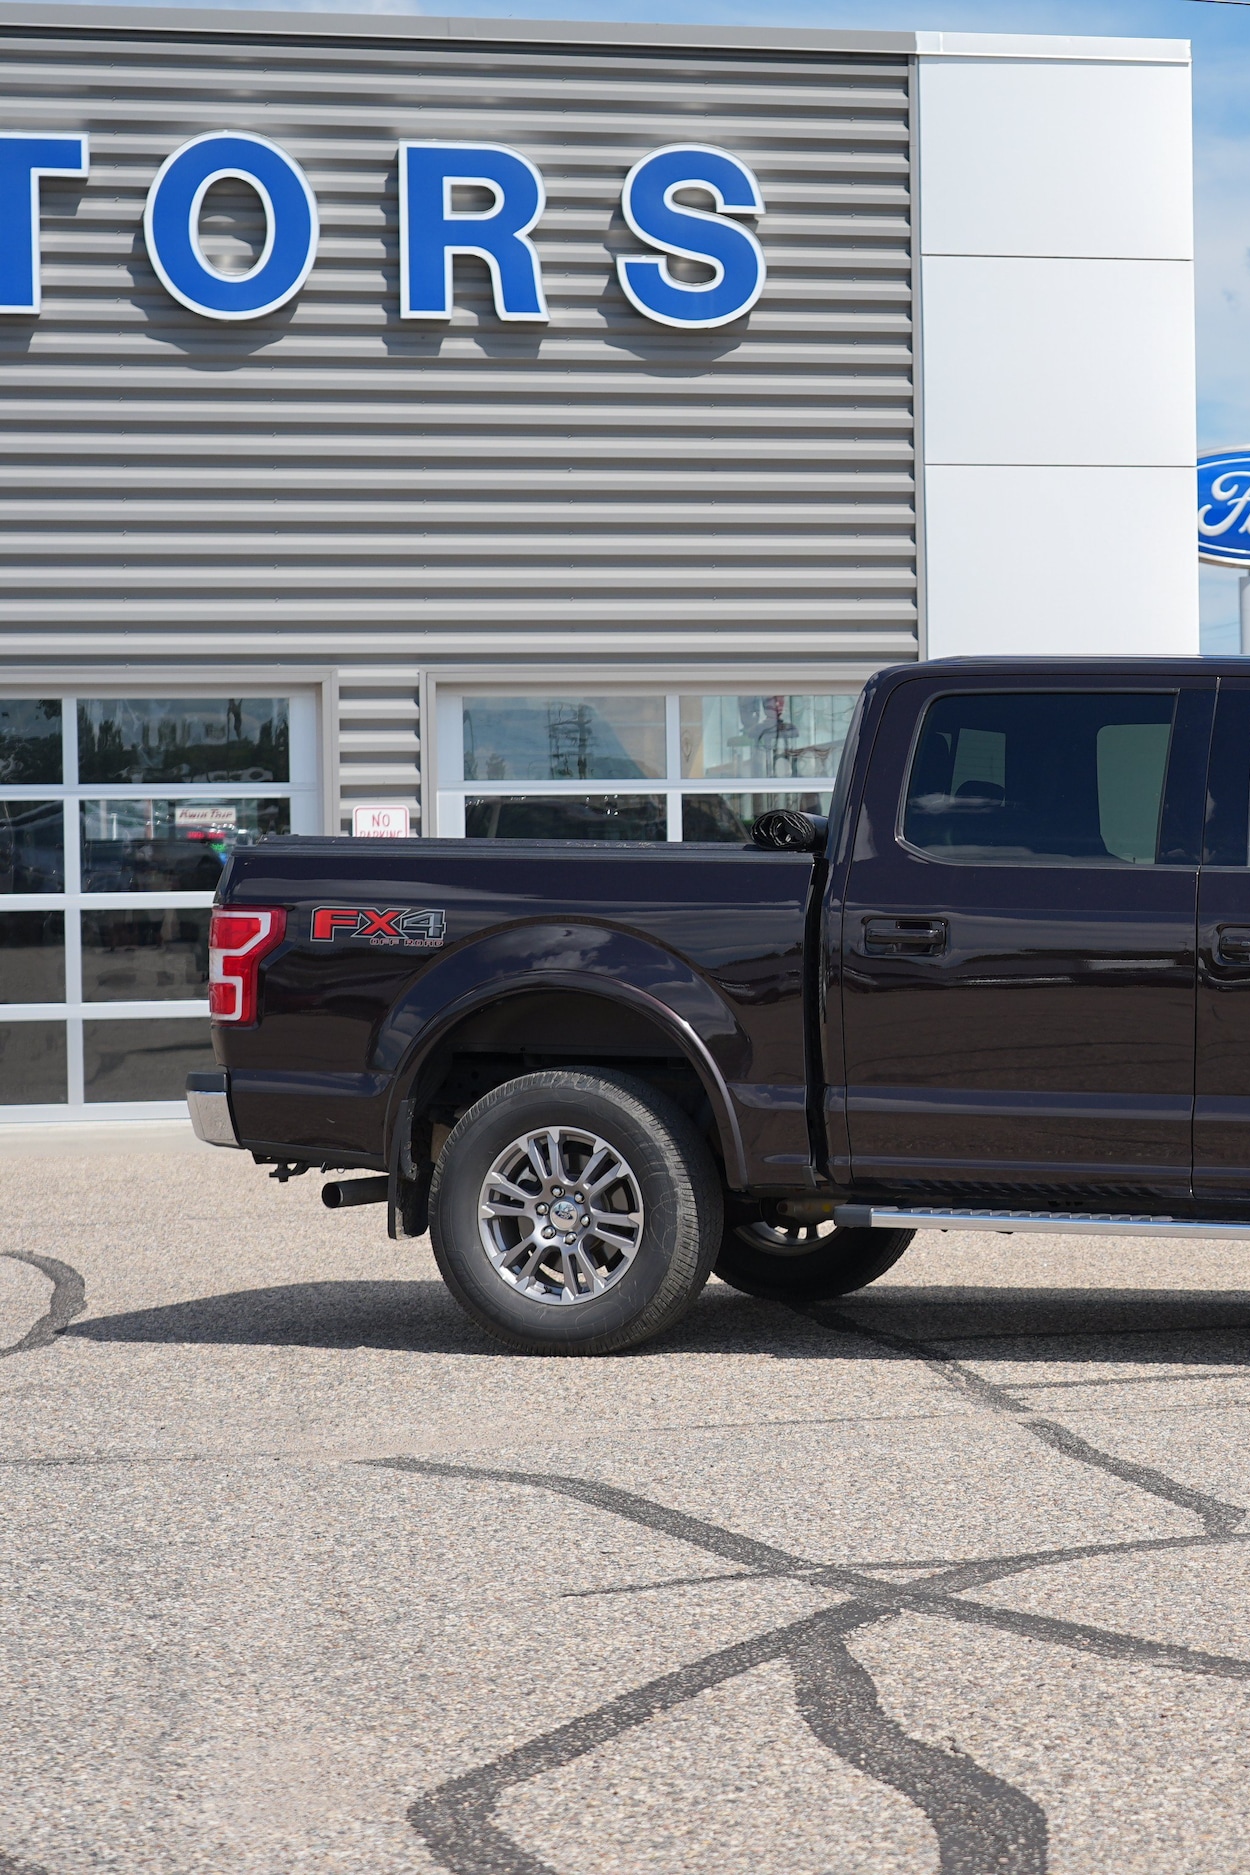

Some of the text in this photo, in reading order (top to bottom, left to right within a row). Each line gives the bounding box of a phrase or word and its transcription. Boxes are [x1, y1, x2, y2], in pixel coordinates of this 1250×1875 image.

[0, 129, 767, 328] TORS
[372, 813, 390, 827] NO
[310, 905, 446, 942] FX4
[370, 937, 444, 947] OFF ROAD
